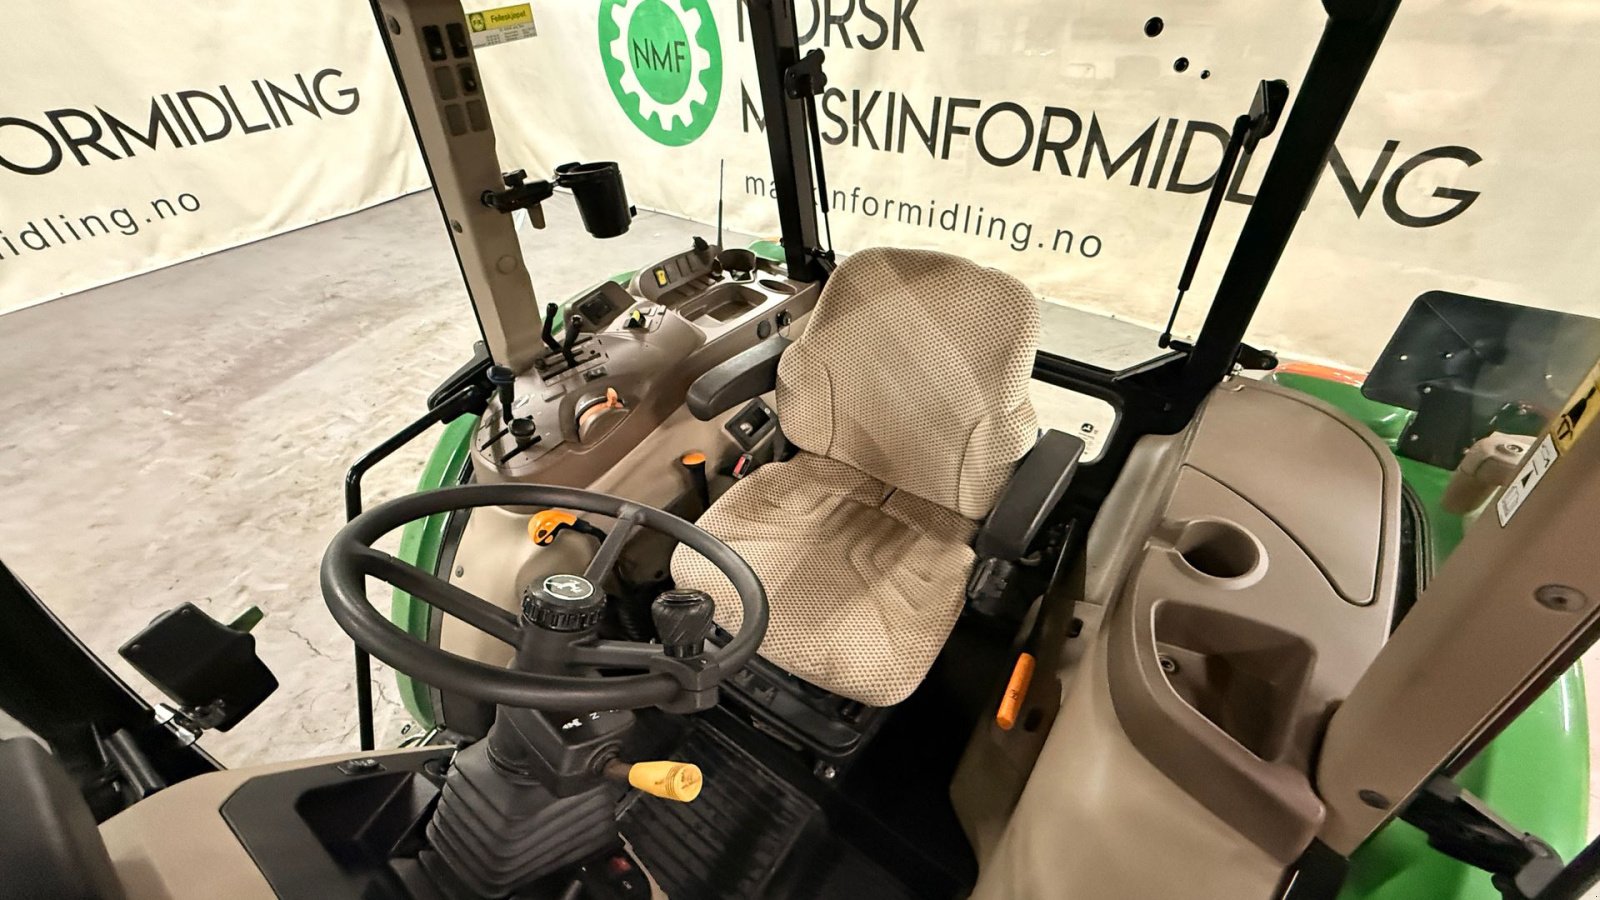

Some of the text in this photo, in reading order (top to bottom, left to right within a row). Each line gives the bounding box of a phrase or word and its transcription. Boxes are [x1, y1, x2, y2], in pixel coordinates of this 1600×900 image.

[632, 38, 686, 73] NMF
[741, 78, 1482, 228] MSKINFORMIDLNG
[0, 192, 201, 260] idling.no
[745, 175, 1102, 258] manformidling.no
